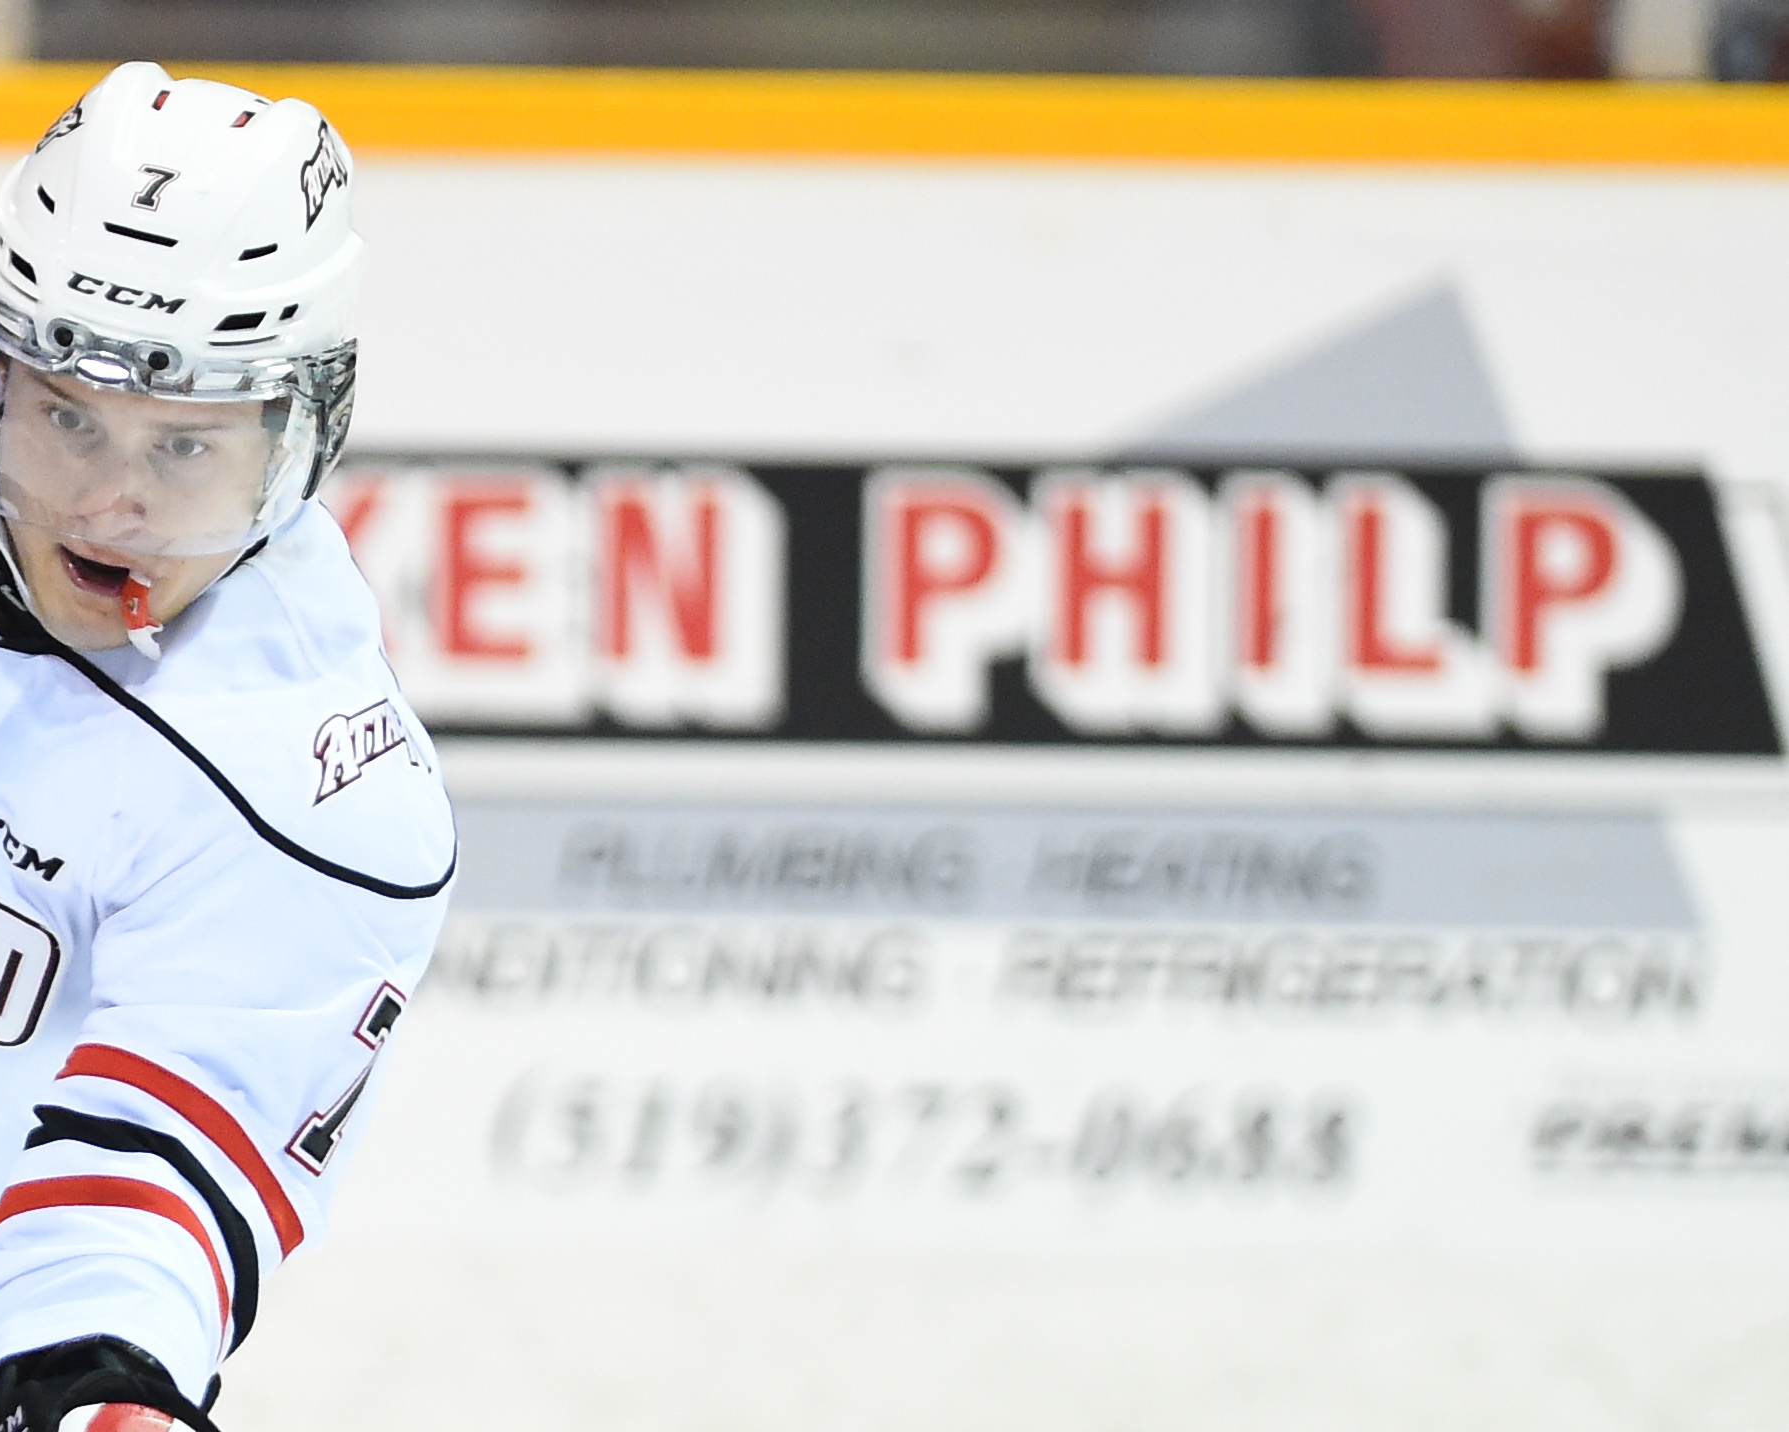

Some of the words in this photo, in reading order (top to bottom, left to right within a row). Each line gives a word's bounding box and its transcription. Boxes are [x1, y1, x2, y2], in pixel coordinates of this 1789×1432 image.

[131, 163, 180, 211] 7
[66, 271, 187, 315] CCM
[872, 472, 1642, 697] PHILP
[556, 822, 979, 908] PLUMBING
[1028, 827, 1378, 912] HEATING
[415, 921, 925, 1003] NDITIONING
[1002, 926, 1704, 1015] REFRIGERATION
[286, 980, 407, 1178] 7
